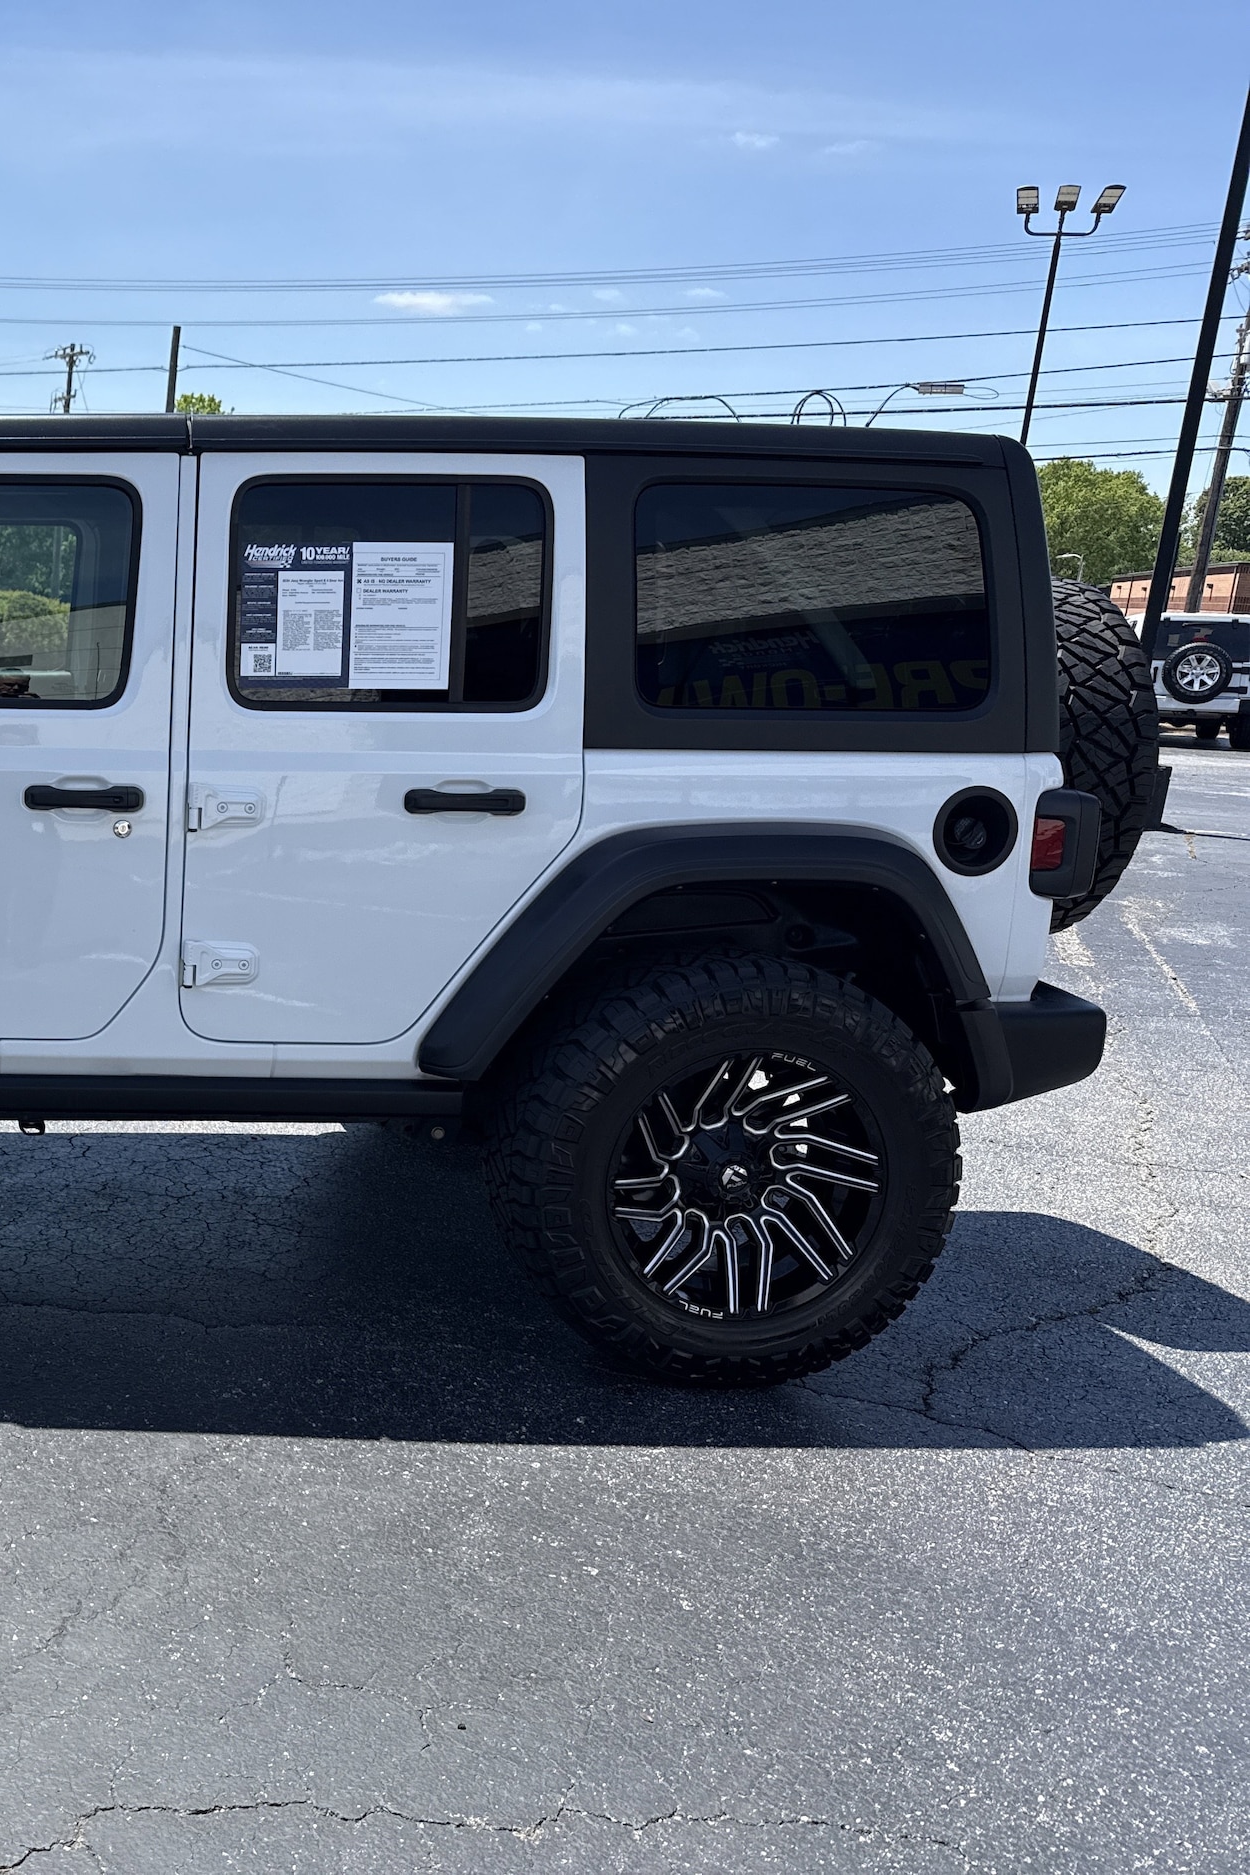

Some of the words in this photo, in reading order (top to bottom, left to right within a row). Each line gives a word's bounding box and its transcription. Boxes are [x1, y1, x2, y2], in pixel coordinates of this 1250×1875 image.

[244, 544, 297, 561] Hendrick
[300, 546, 316, 560] 10
[315, 546, 350, 554] YEAR/
[771, 1052, 816, 1072] FUEL
[679, 1299, 724, 1320] FUEL
